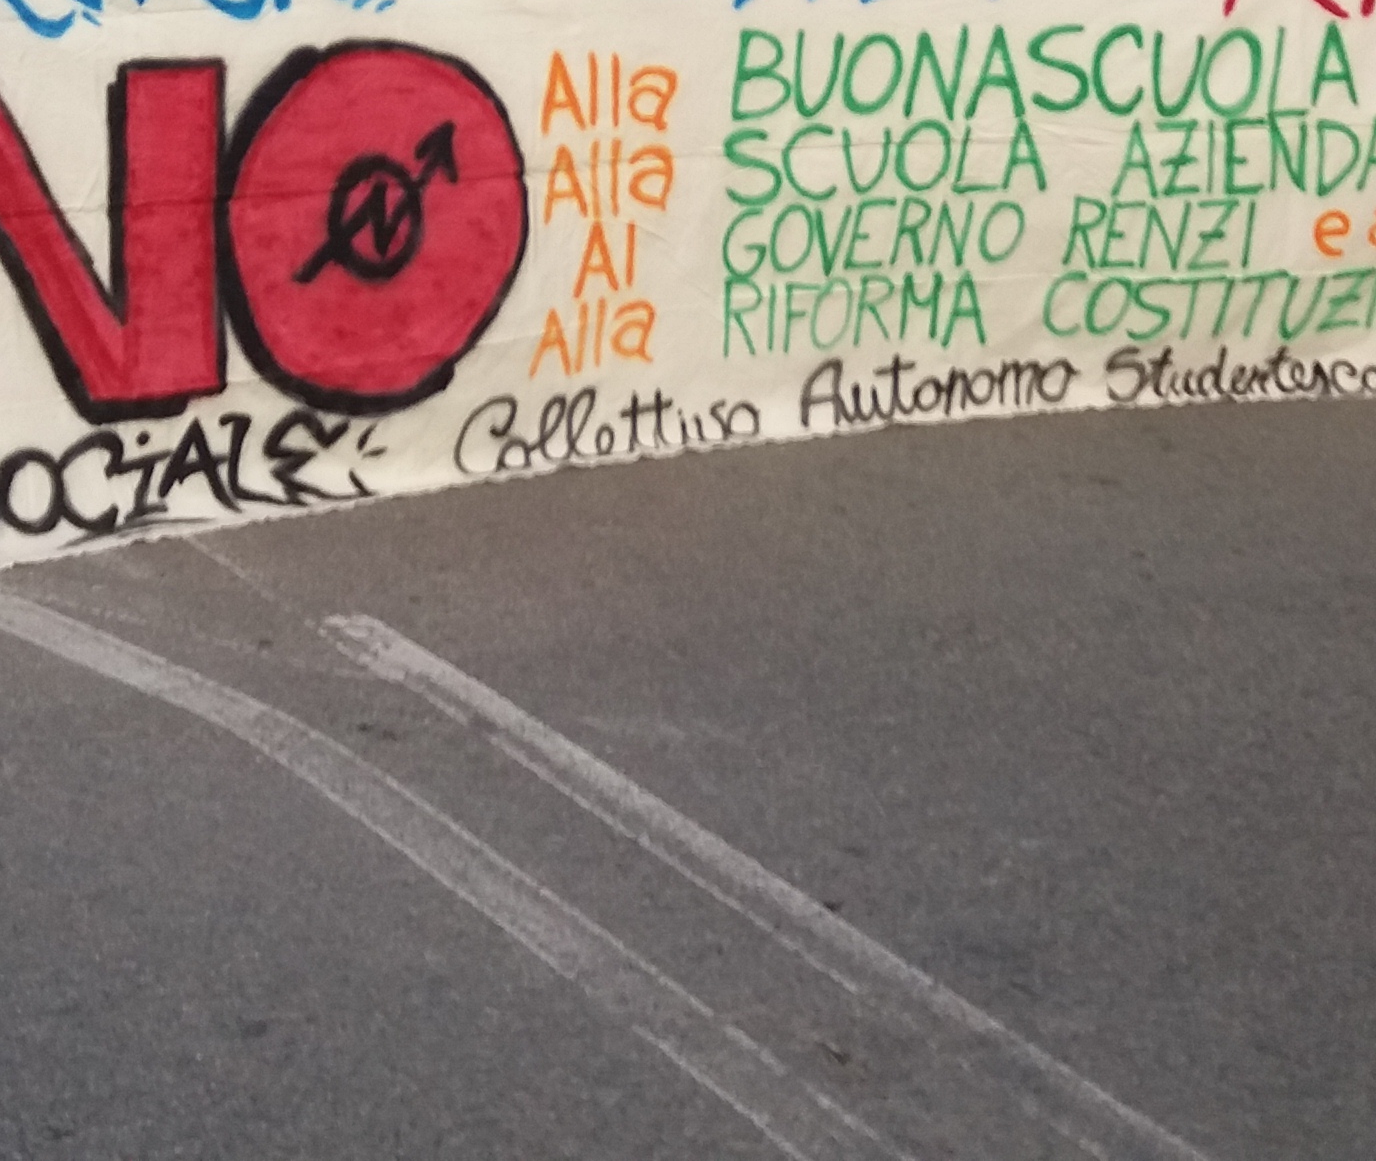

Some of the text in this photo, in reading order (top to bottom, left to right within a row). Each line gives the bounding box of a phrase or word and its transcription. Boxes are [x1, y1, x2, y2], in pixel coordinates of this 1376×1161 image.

[541, 51, 679, 135] Alla
[543, 142, 676, 220] Alla
[723, 114, 1048, 206] SCUOLA
[573, 223, 638, 299] Al
[721, 197, 1026, 277] GOVERNO
[1062, 195, 1258, 271] RENZI
[1312, 210, 1352, 258] e
[528, 299, 657, 379] Alla
[723, 269, 987, 357] RIFORMA
[800, 358, 1080, 429] Autonomo
